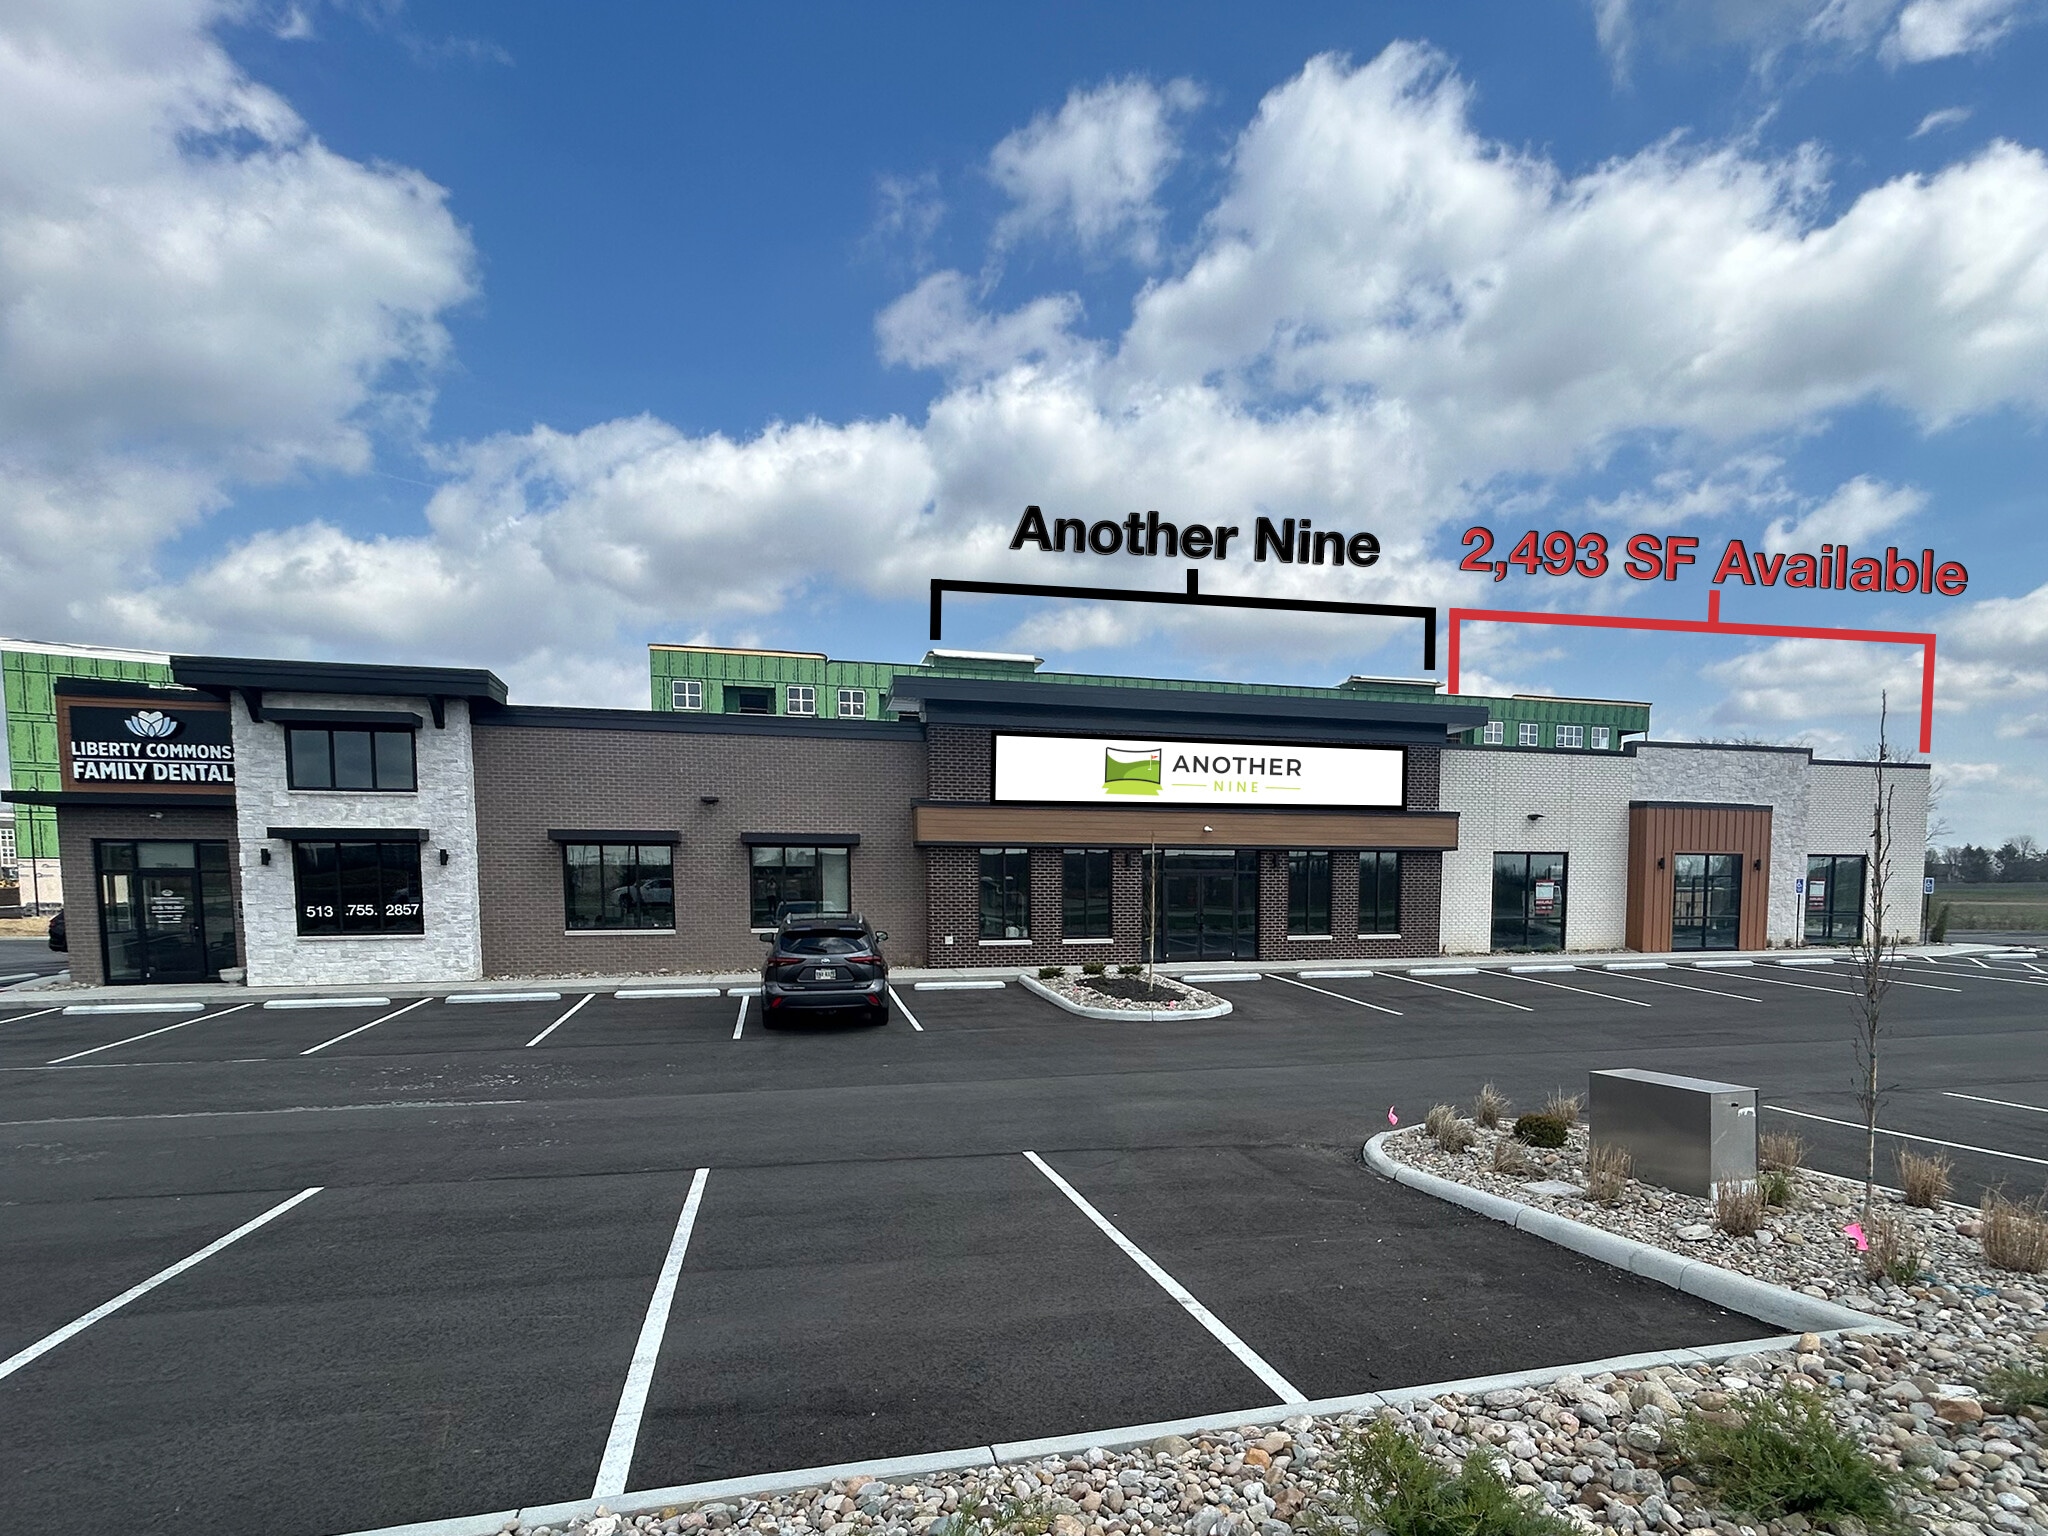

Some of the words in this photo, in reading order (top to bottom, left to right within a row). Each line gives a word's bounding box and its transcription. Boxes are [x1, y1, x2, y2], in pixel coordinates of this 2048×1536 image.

[71, 741, 141, 757] LIBERTY
[146, 743, 232, 759] COMMONS
[73, 761, 147, 780] FAMILY
[153, 763, 234, 782] DENTAL
[1172, 755, 1302, 776] ANOTHER
[1214, 780, 1258, 793] NINE
[306, 905, 334, 918] 513
[385, 904, 420, 916] 2857
